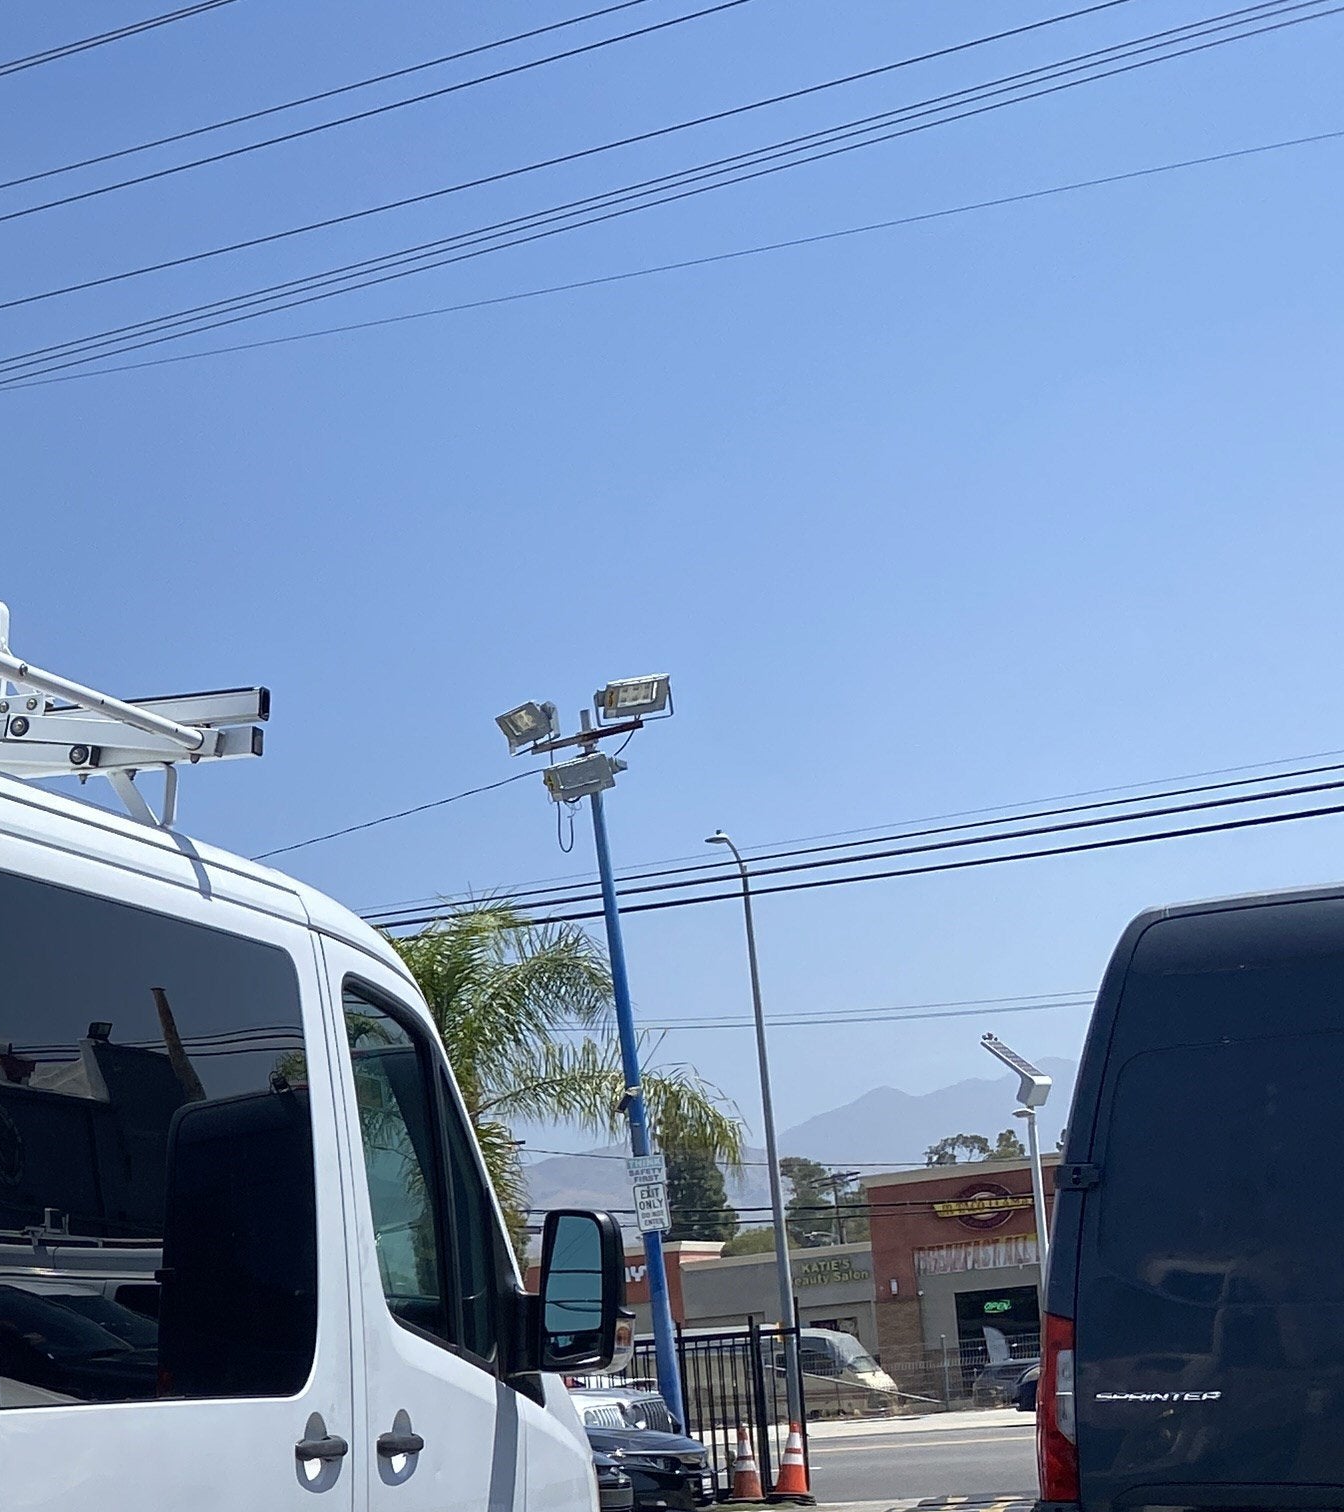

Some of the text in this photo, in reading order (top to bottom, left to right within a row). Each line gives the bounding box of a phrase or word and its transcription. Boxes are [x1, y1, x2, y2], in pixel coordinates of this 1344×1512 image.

[628, 1167, 662, 1177] SAFETY
[634, 1174, 659, 1182] FIRST
[640, 1188, 660, 1199] EXIT
[639, 1199, 663, 1210] ONLY
[801, 1259, 851, 1273] KATIE'S
[794, 1270, 869, 1286] eauty Salon
[984, 1301, 1011, 1313] OPEN
[1095, 1391, 1222, 1402] SPRINTER
